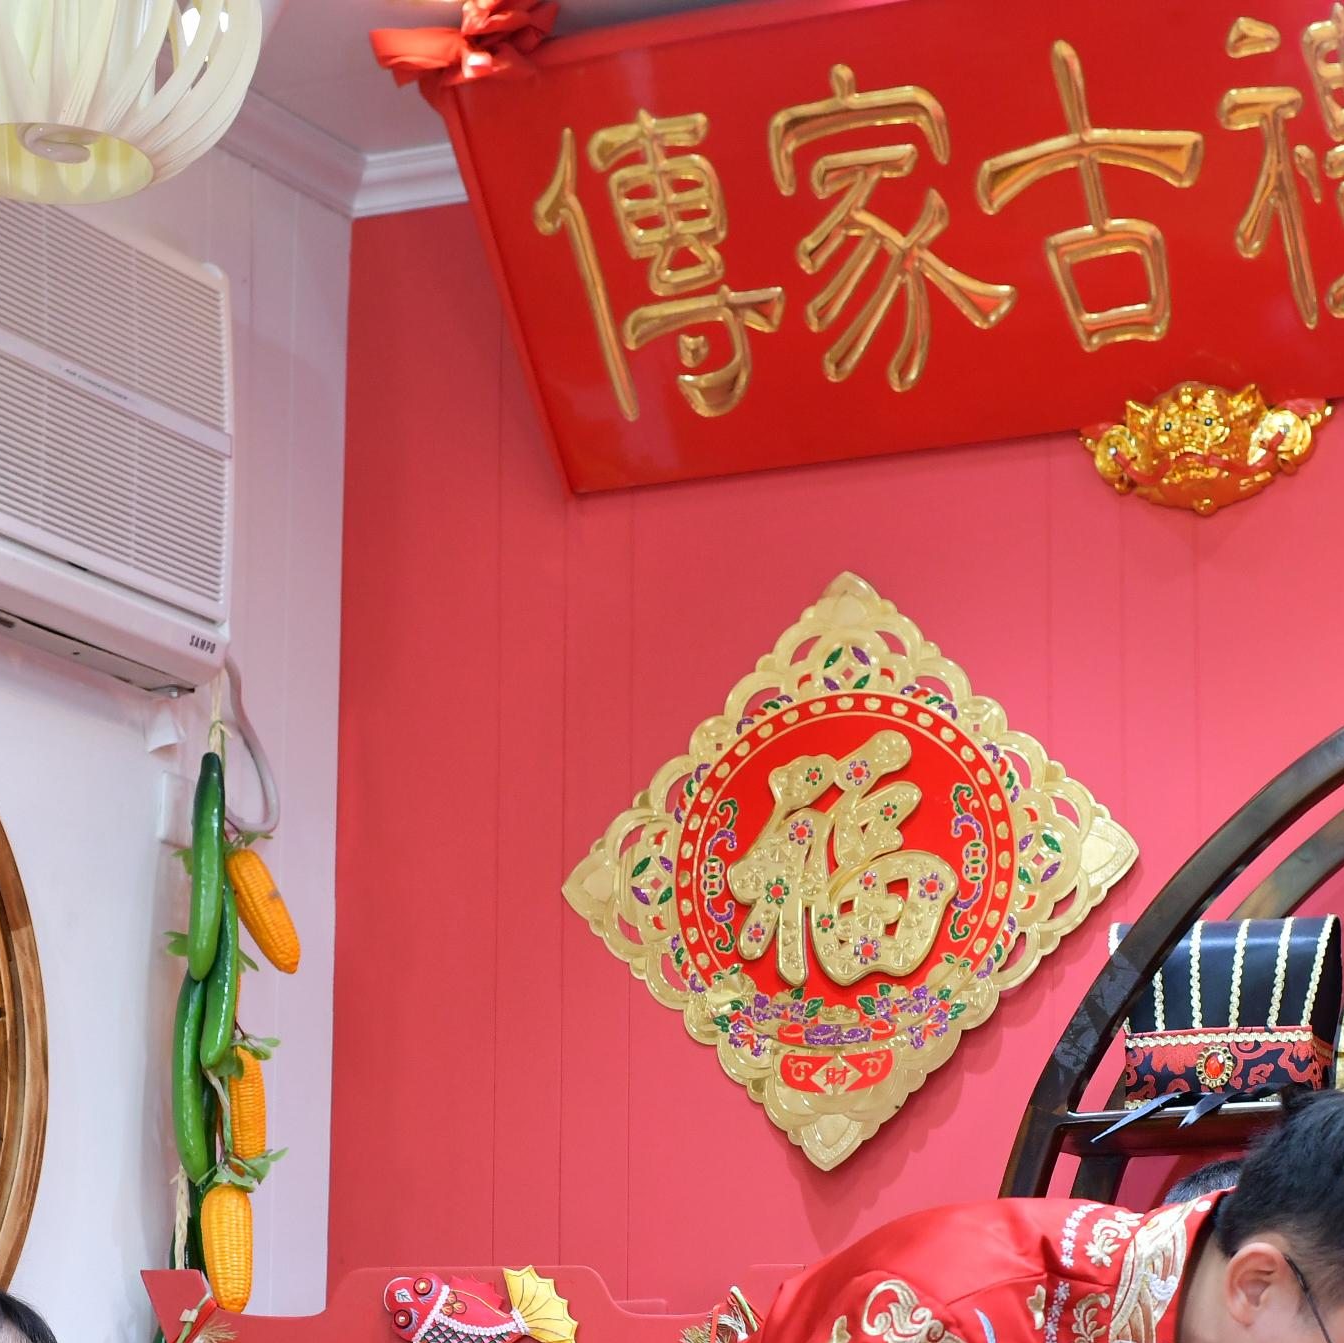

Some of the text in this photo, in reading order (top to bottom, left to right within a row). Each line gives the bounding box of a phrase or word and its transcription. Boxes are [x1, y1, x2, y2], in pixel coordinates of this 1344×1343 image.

[189, 634, 216, 654] SAMPO
[727, 729, 958, 987] 福
[823, 1065, 851, 1087] 財
